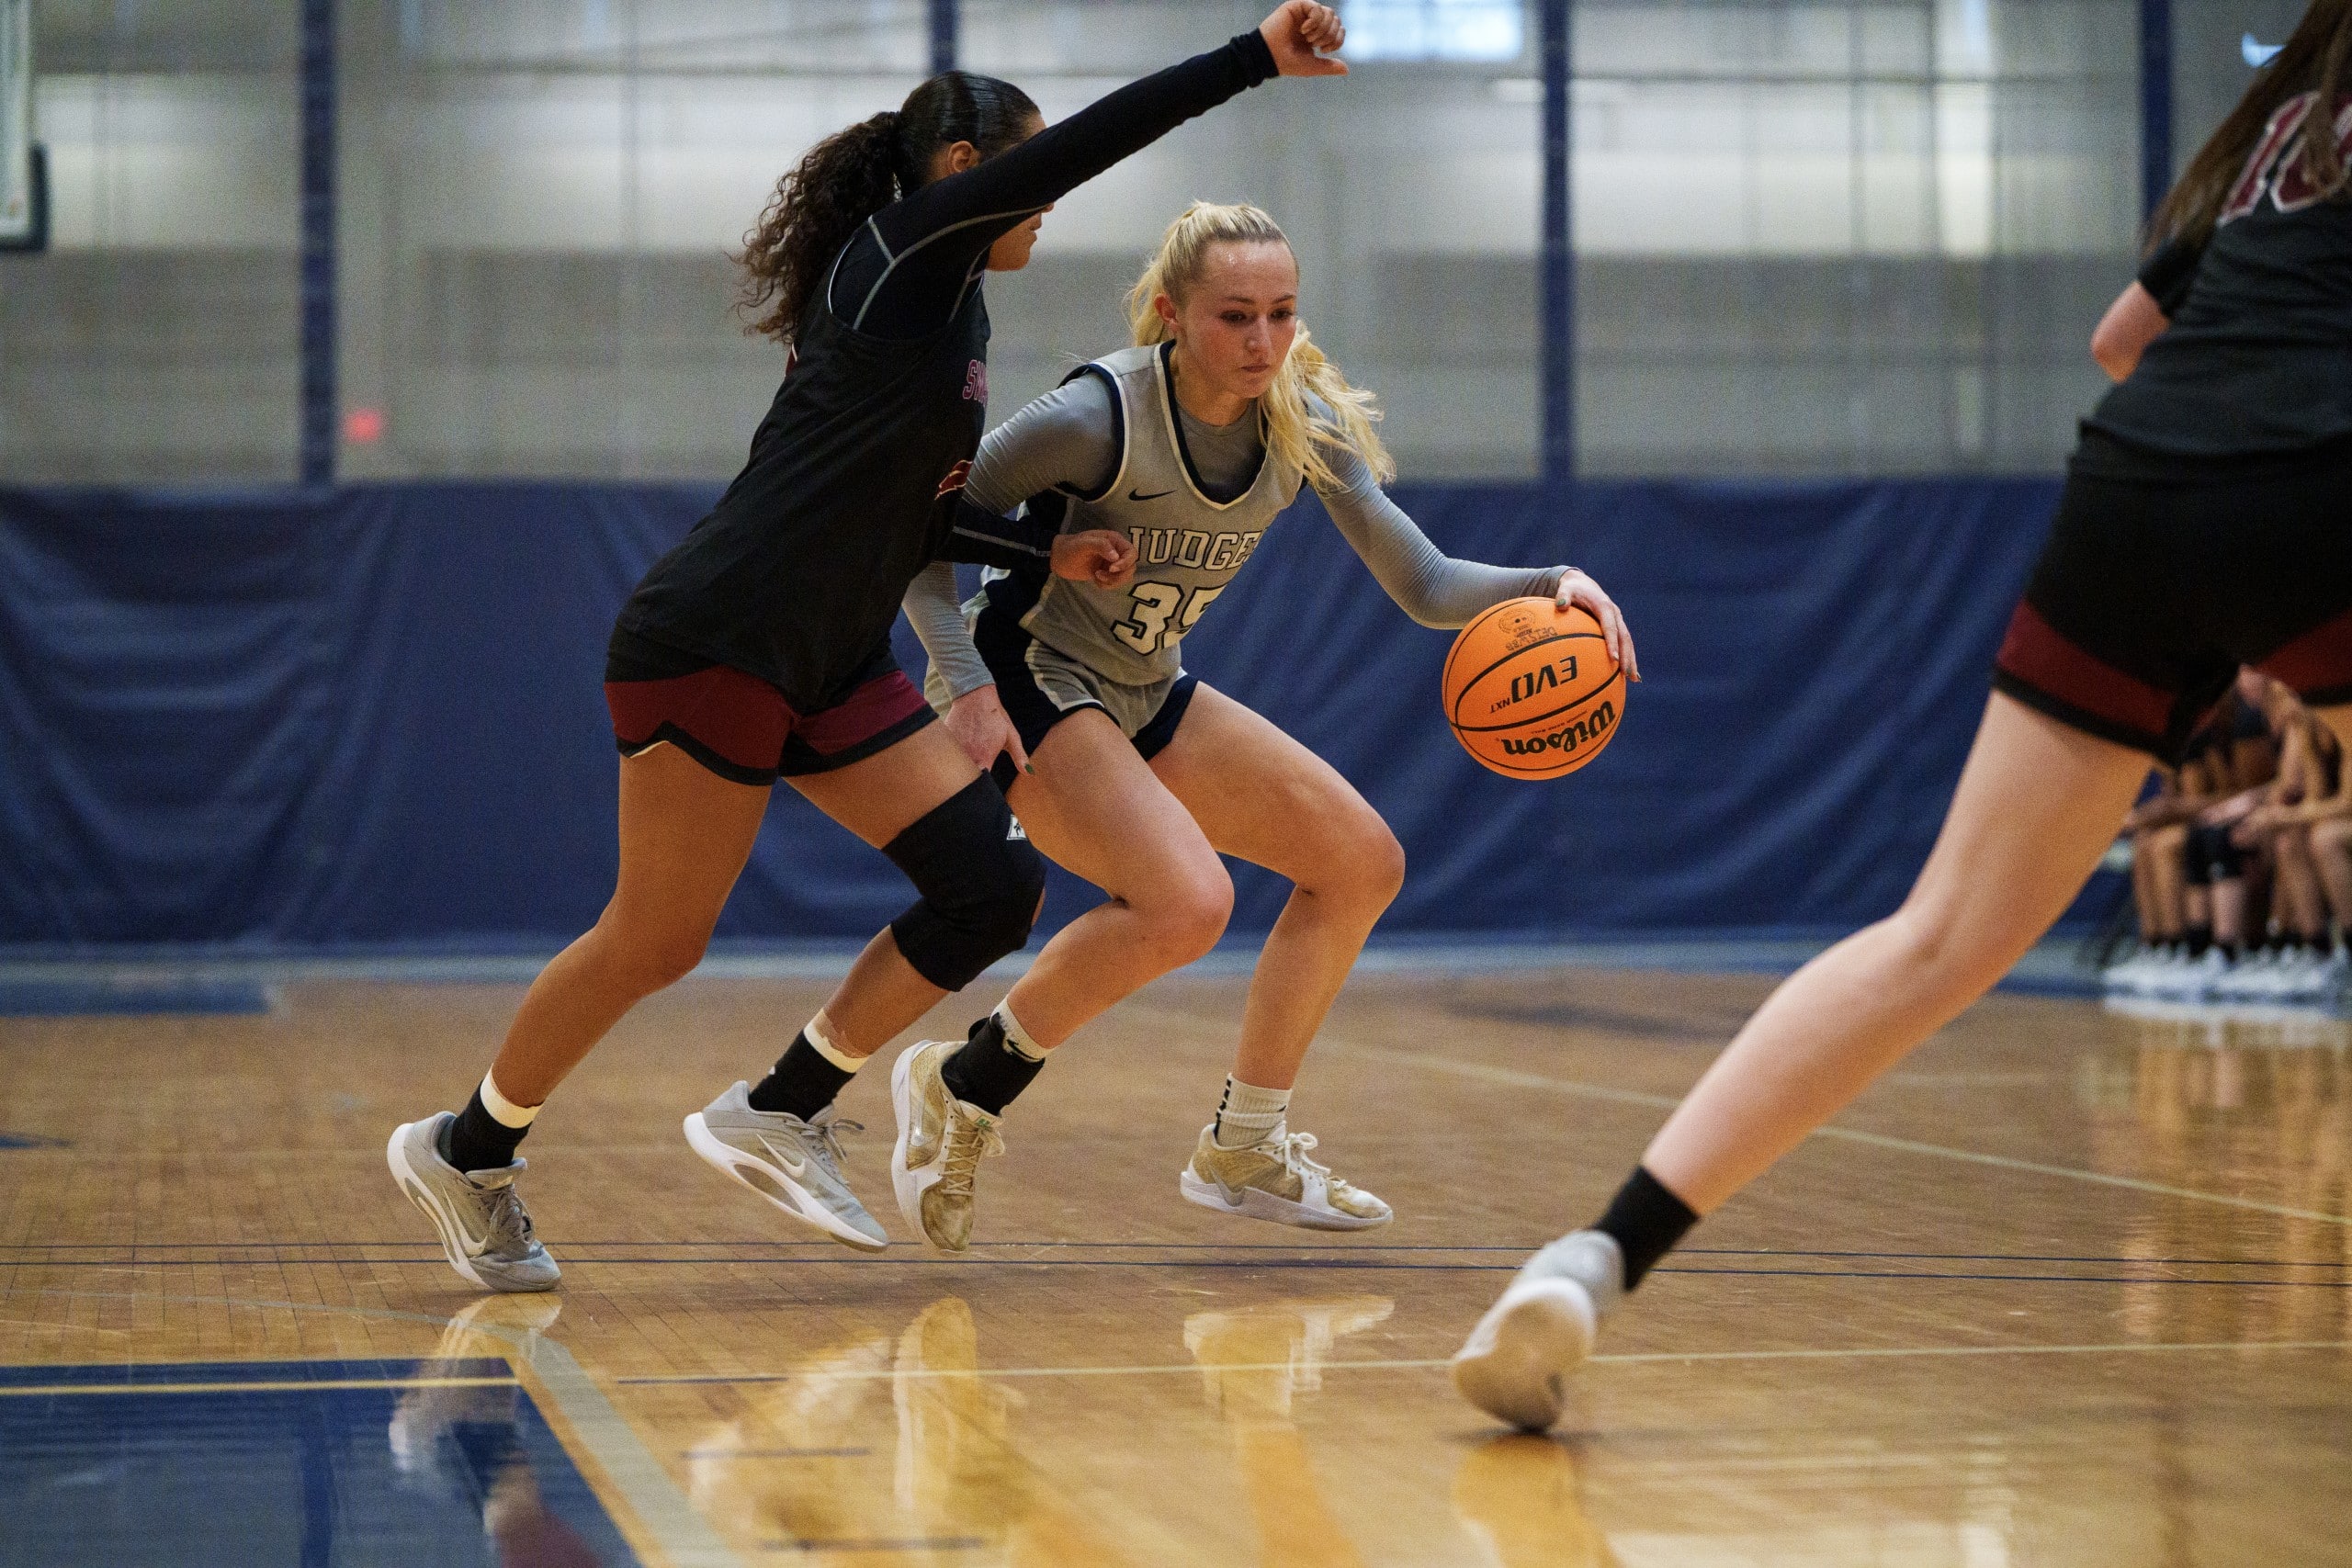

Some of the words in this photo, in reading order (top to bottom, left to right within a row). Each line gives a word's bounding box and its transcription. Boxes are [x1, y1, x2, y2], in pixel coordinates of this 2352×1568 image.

[1510, 655, 1578, 704] EVO
[1489, 696, 1511, 714] NXT
[1500, 700, 1616, 756] Wilson
